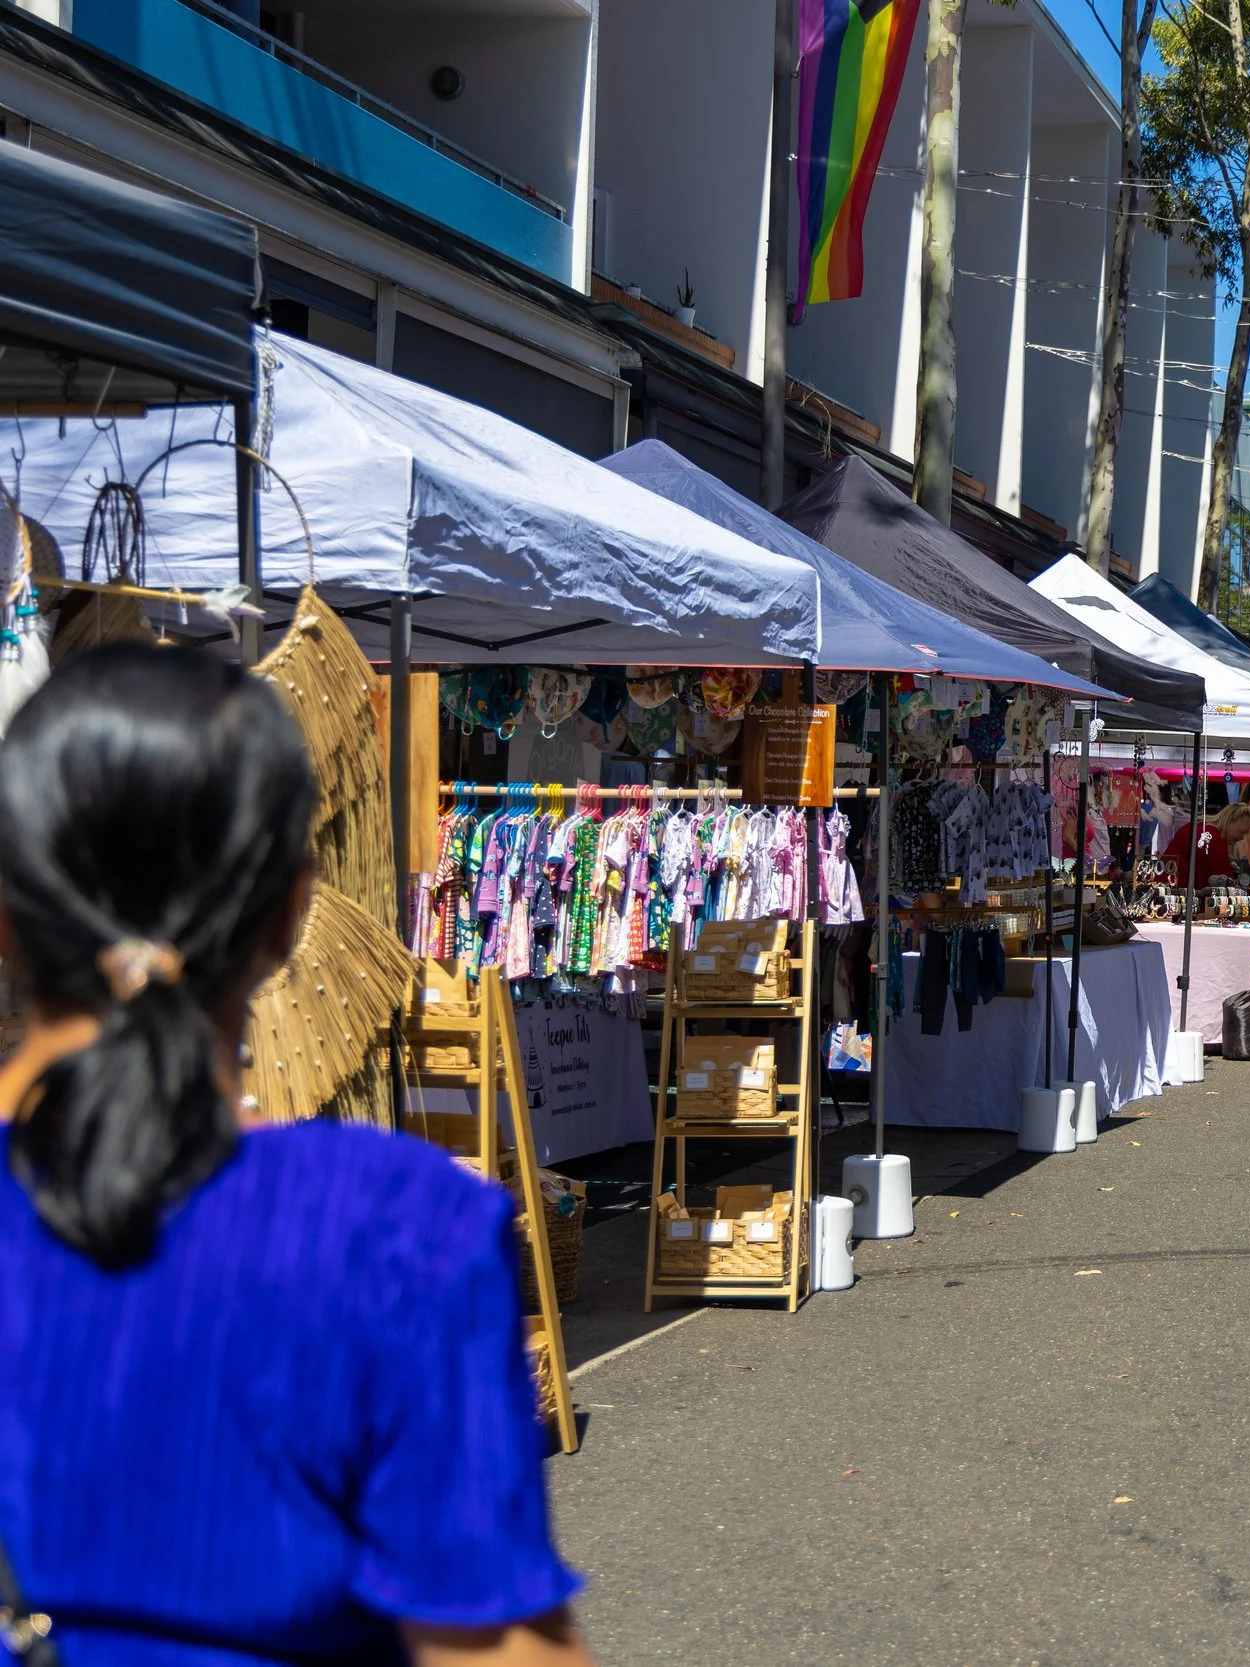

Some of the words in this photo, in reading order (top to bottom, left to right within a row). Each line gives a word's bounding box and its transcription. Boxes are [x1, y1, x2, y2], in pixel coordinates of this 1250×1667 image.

[748, 704, 763, 716] Our
[763, 705, 796, 716] Chocolate
[797, 706, 830, 718] Collection
[546, 1017, 573, 1056] Teepee
